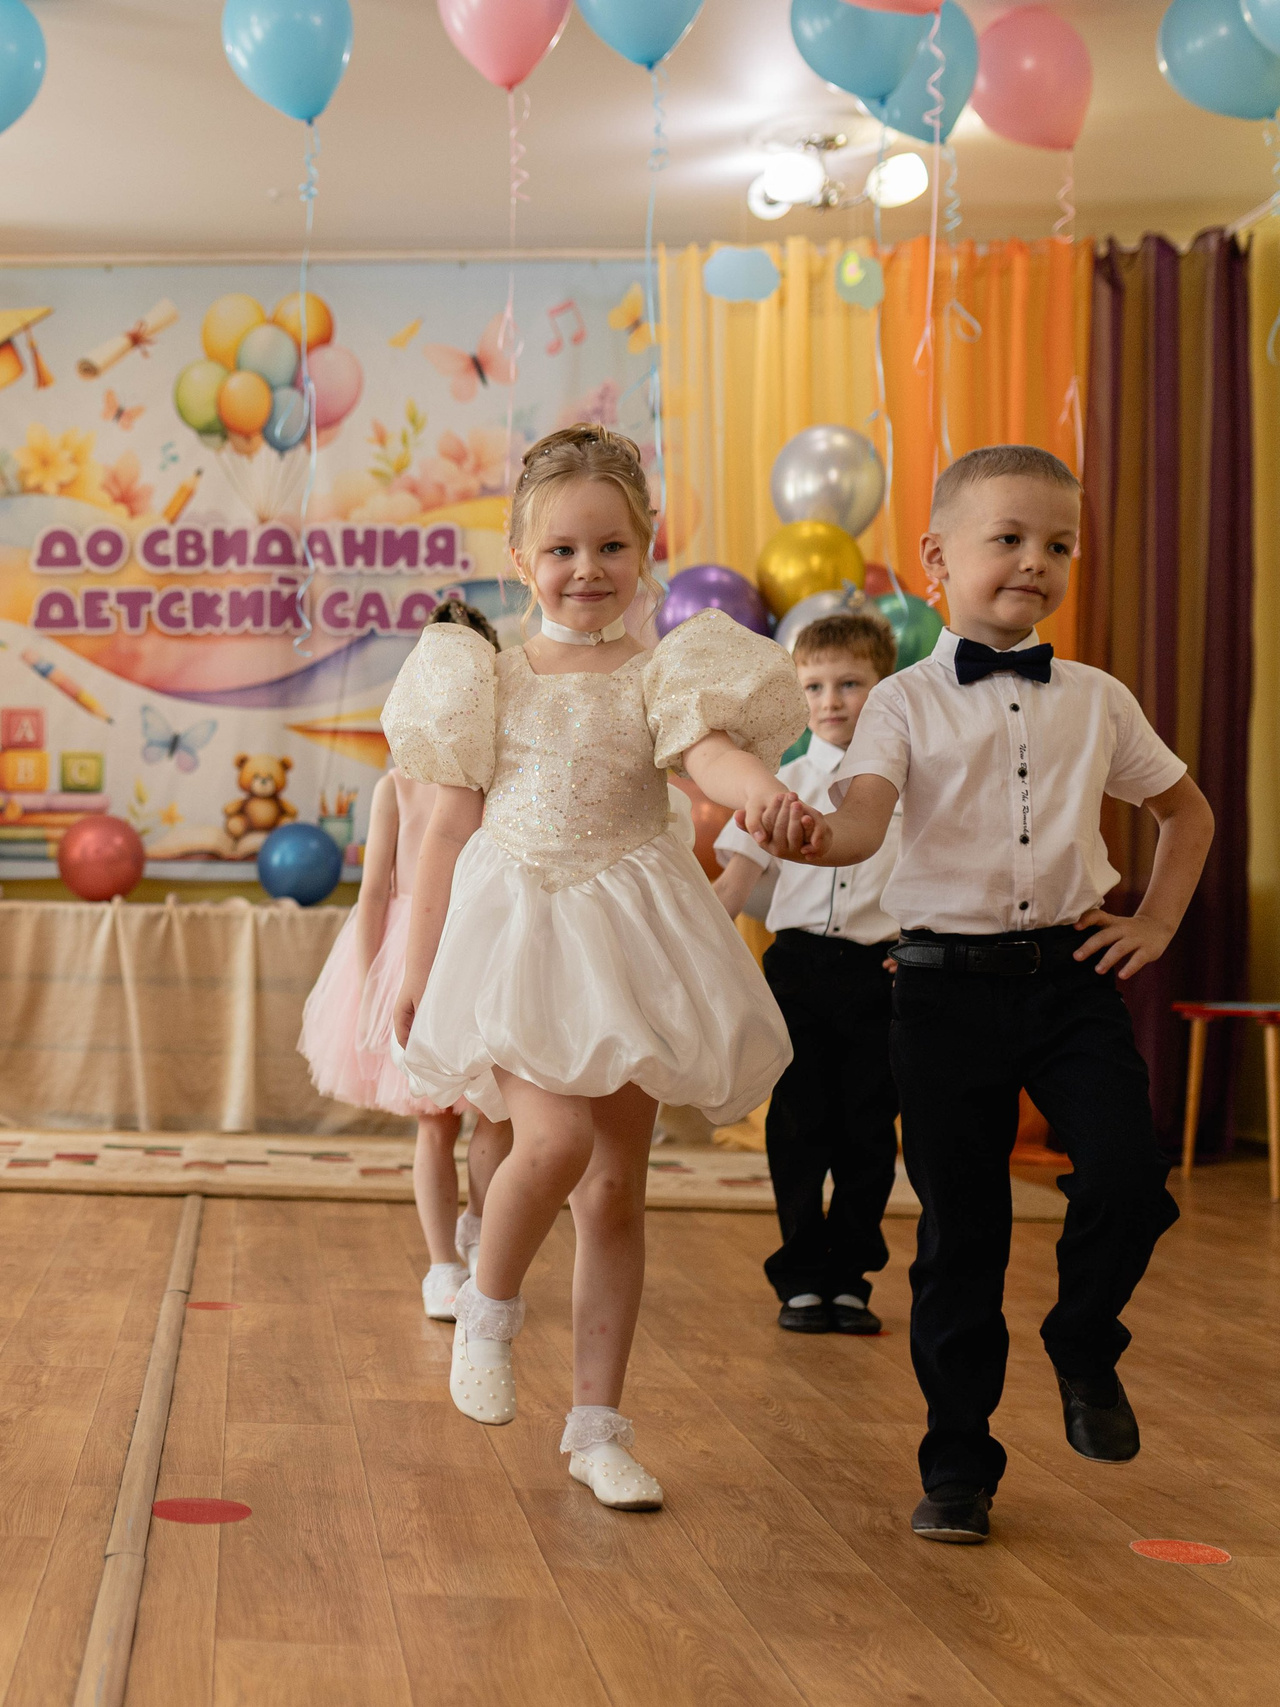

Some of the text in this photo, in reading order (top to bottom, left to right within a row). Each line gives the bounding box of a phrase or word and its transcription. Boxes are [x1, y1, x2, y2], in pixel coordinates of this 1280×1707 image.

[35, 528, 124, 568] ДО
[33, 576, 460, 630] ДЕТСКИЙ САД
